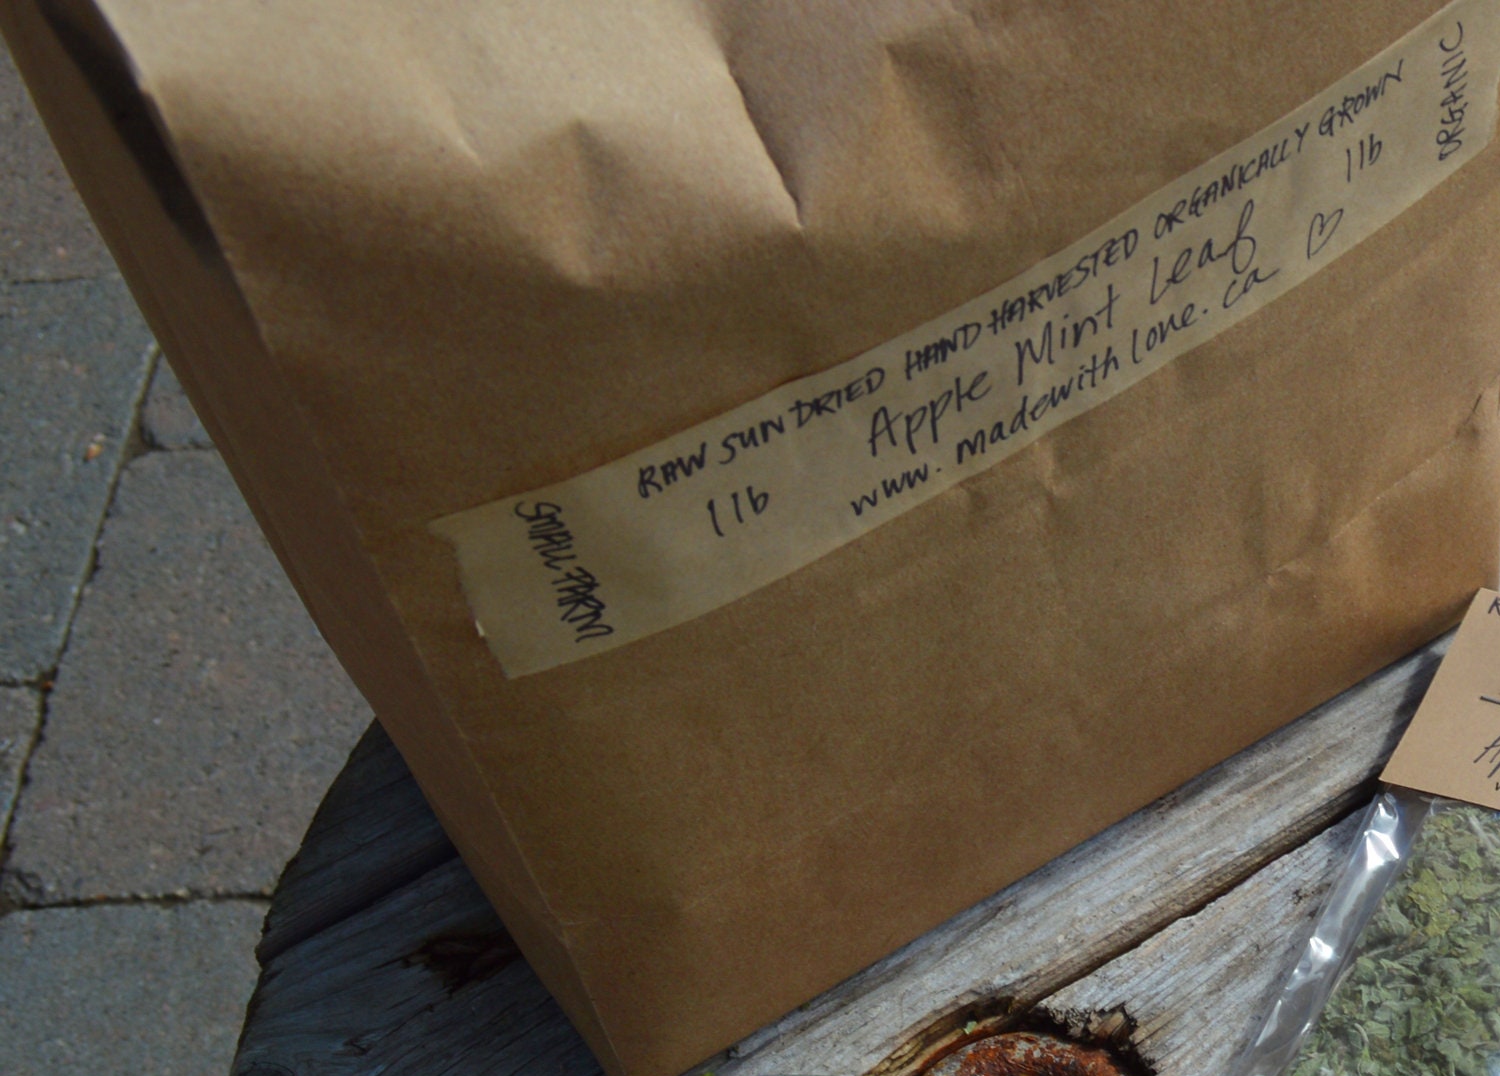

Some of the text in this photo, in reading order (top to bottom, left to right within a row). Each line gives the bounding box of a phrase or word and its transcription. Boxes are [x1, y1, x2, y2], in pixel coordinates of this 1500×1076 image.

[1436, 20, 1469, 161] ORGANIC
[638, 442, 707, 498] RAW
[1154, 122, 1310, 239] ORGANICALLY
[1318, 59, 1404, 137] GROWN
[867, 198, 1256, 456] Apple Mint Leaf
